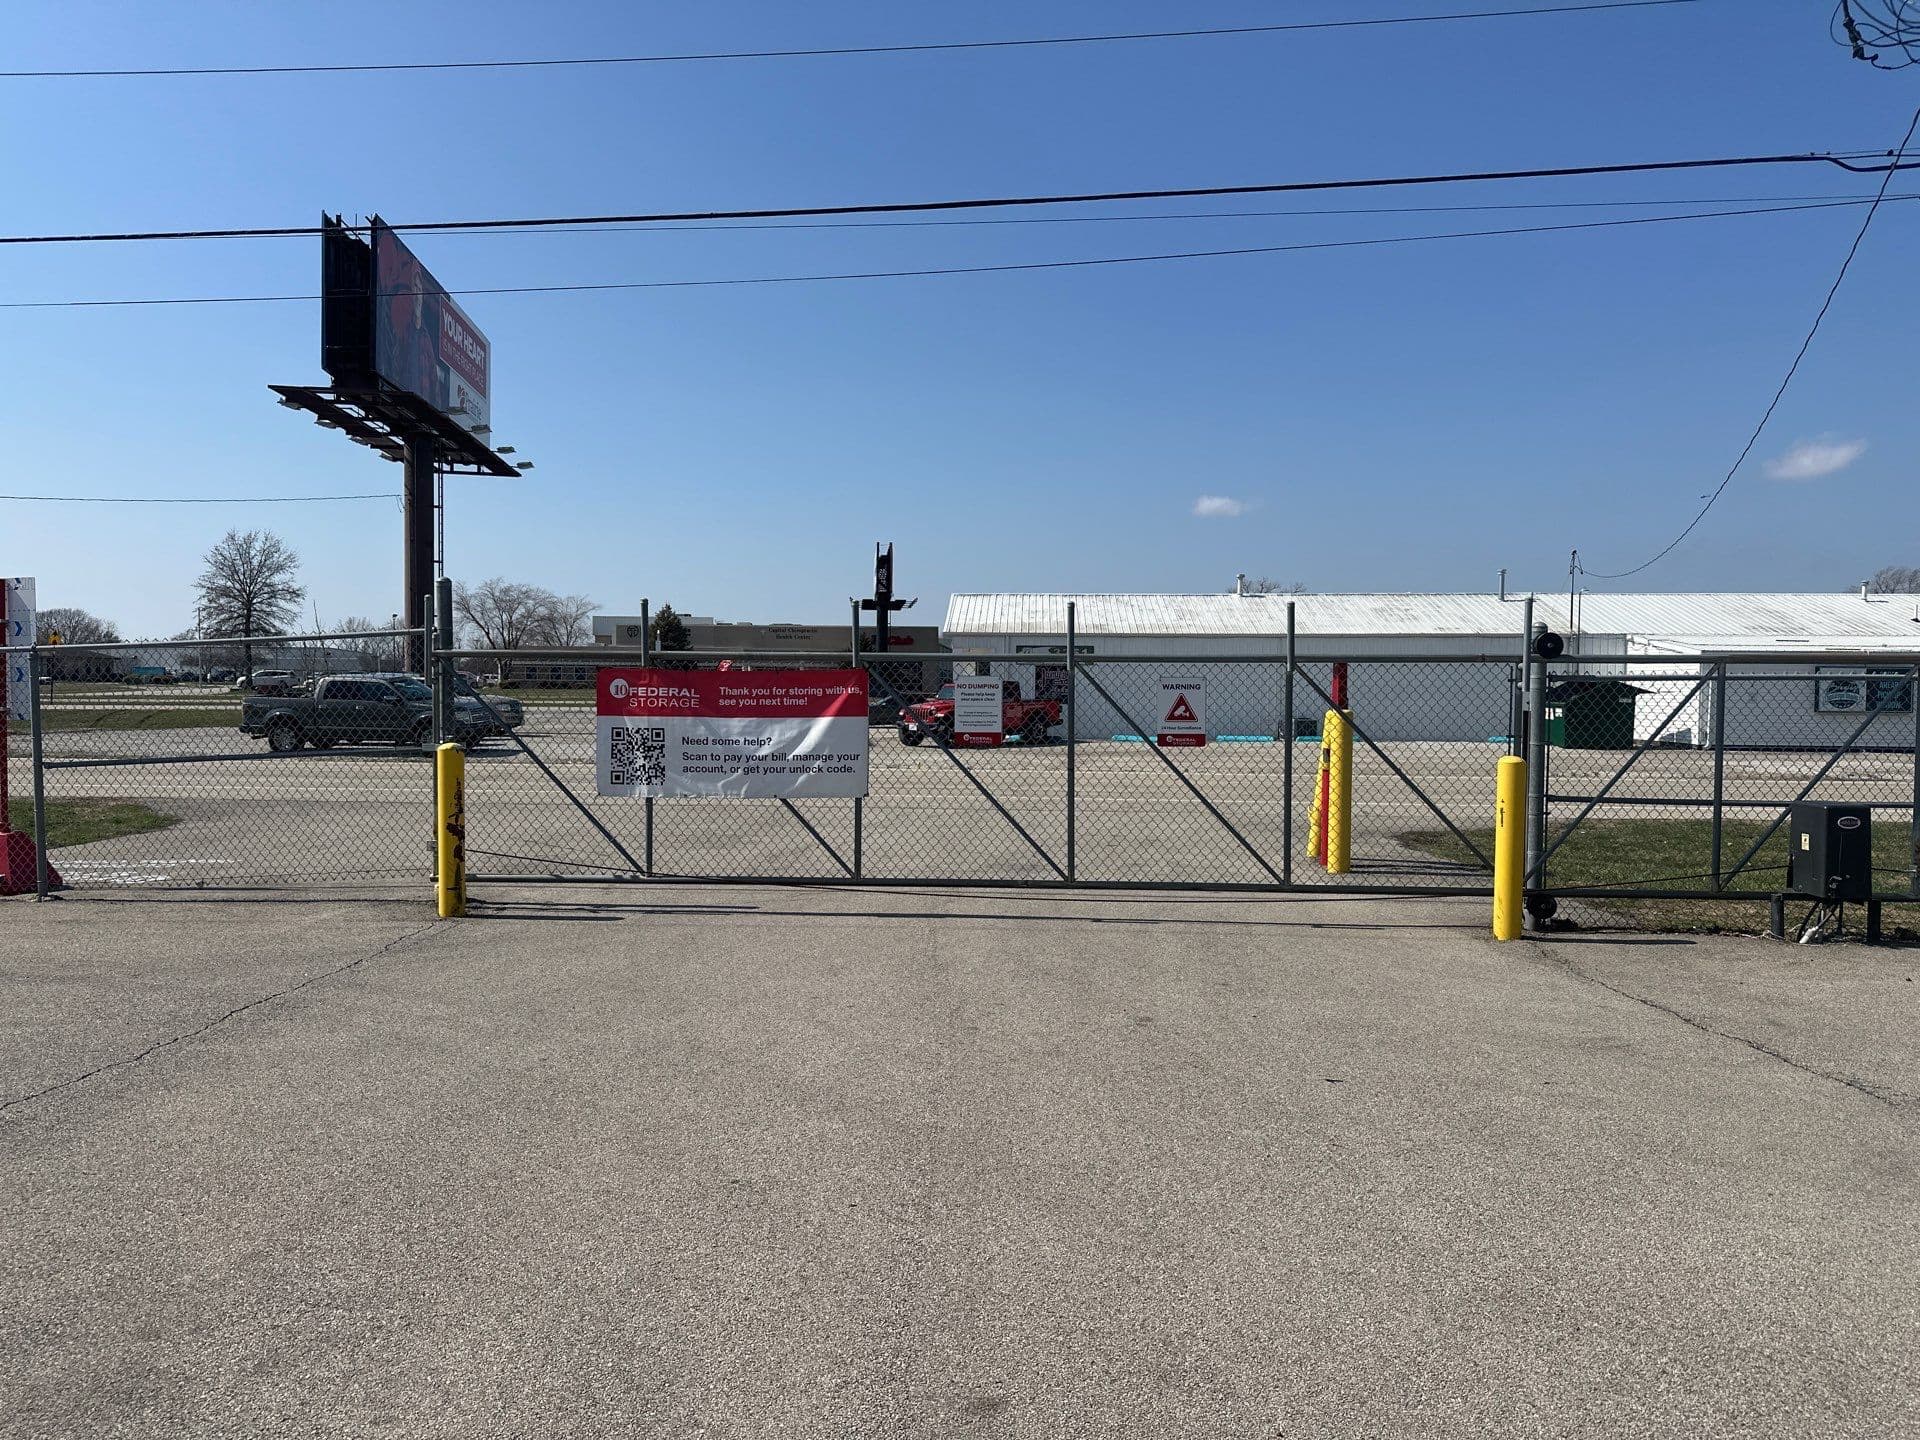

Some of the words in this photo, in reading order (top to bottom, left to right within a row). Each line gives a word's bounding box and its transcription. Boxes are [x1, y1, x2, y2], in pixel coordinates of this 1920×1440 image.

[443, 309, 463, 348] YOUR
[464, 331, 484, 369] HEART
[630, 687, 700, 697] FEDERAL
[719, 686, 749, 696] Thank
[752, 688, 770, 697] you
[772, 686, 786, 695] for
[789, 686, 822, 697] storing
[825, 686, 846, 695] with
[847, 686, 863, 696] us,
[630, 698, 700, 708] STORAGE
[739, 698, 756, 707] you
[759, 697, 781, 706] next
[783, 696, 808, 706] time!
[682, 736, 708, 745] Need
[744, 737, 772, 747] help?
[682, 752, 708, 761] Scan
[710, 753, 720, 761] to
[724, 754, 742, 763] pay
[746, 754, 769, 763] your
[772, 753, 789, 762] bill,
[792, 754, 834, 763] manage
[837, 754, 860, 762] your
[682, 765, 726, 774] account,
[744, 765, 760, 775] get
[763, 766, 786, 775] your
[790, 765, 824, 773] unlock
[827, 765, 855, 773] code.
